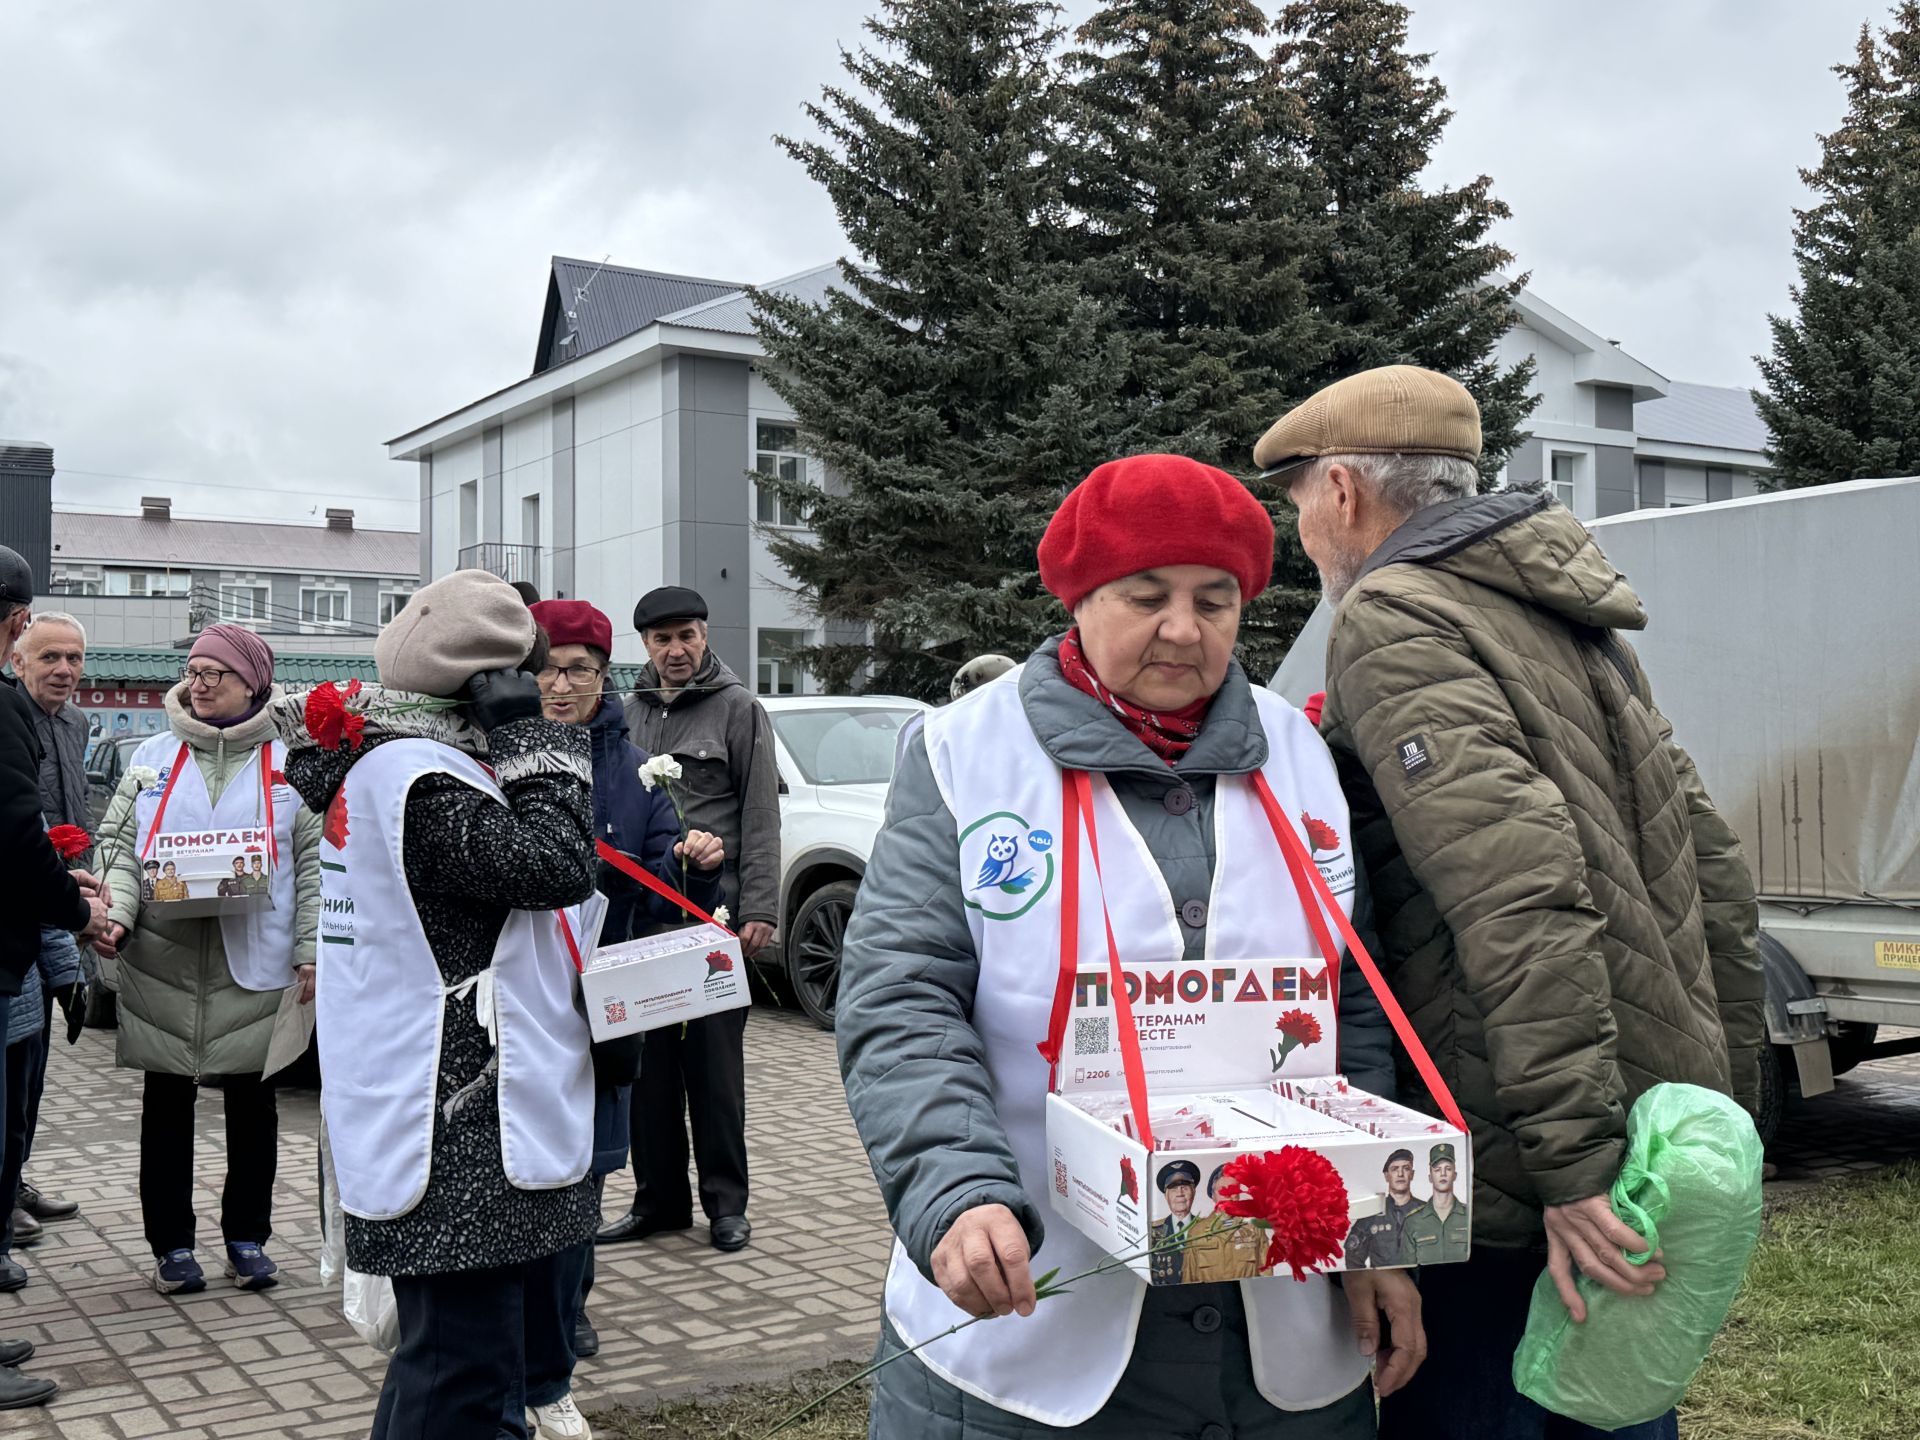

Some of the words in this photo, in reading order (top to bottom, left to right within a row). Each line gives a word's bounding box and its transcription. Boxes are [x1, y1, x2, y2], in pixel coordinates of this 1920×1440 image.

[158, 830, 266, 849] ПОМОГАЕМ
[1076, 967, 1328, 1008] ПОМОГАЕМ
[1086, 1070, 1110, 1079] 2206
